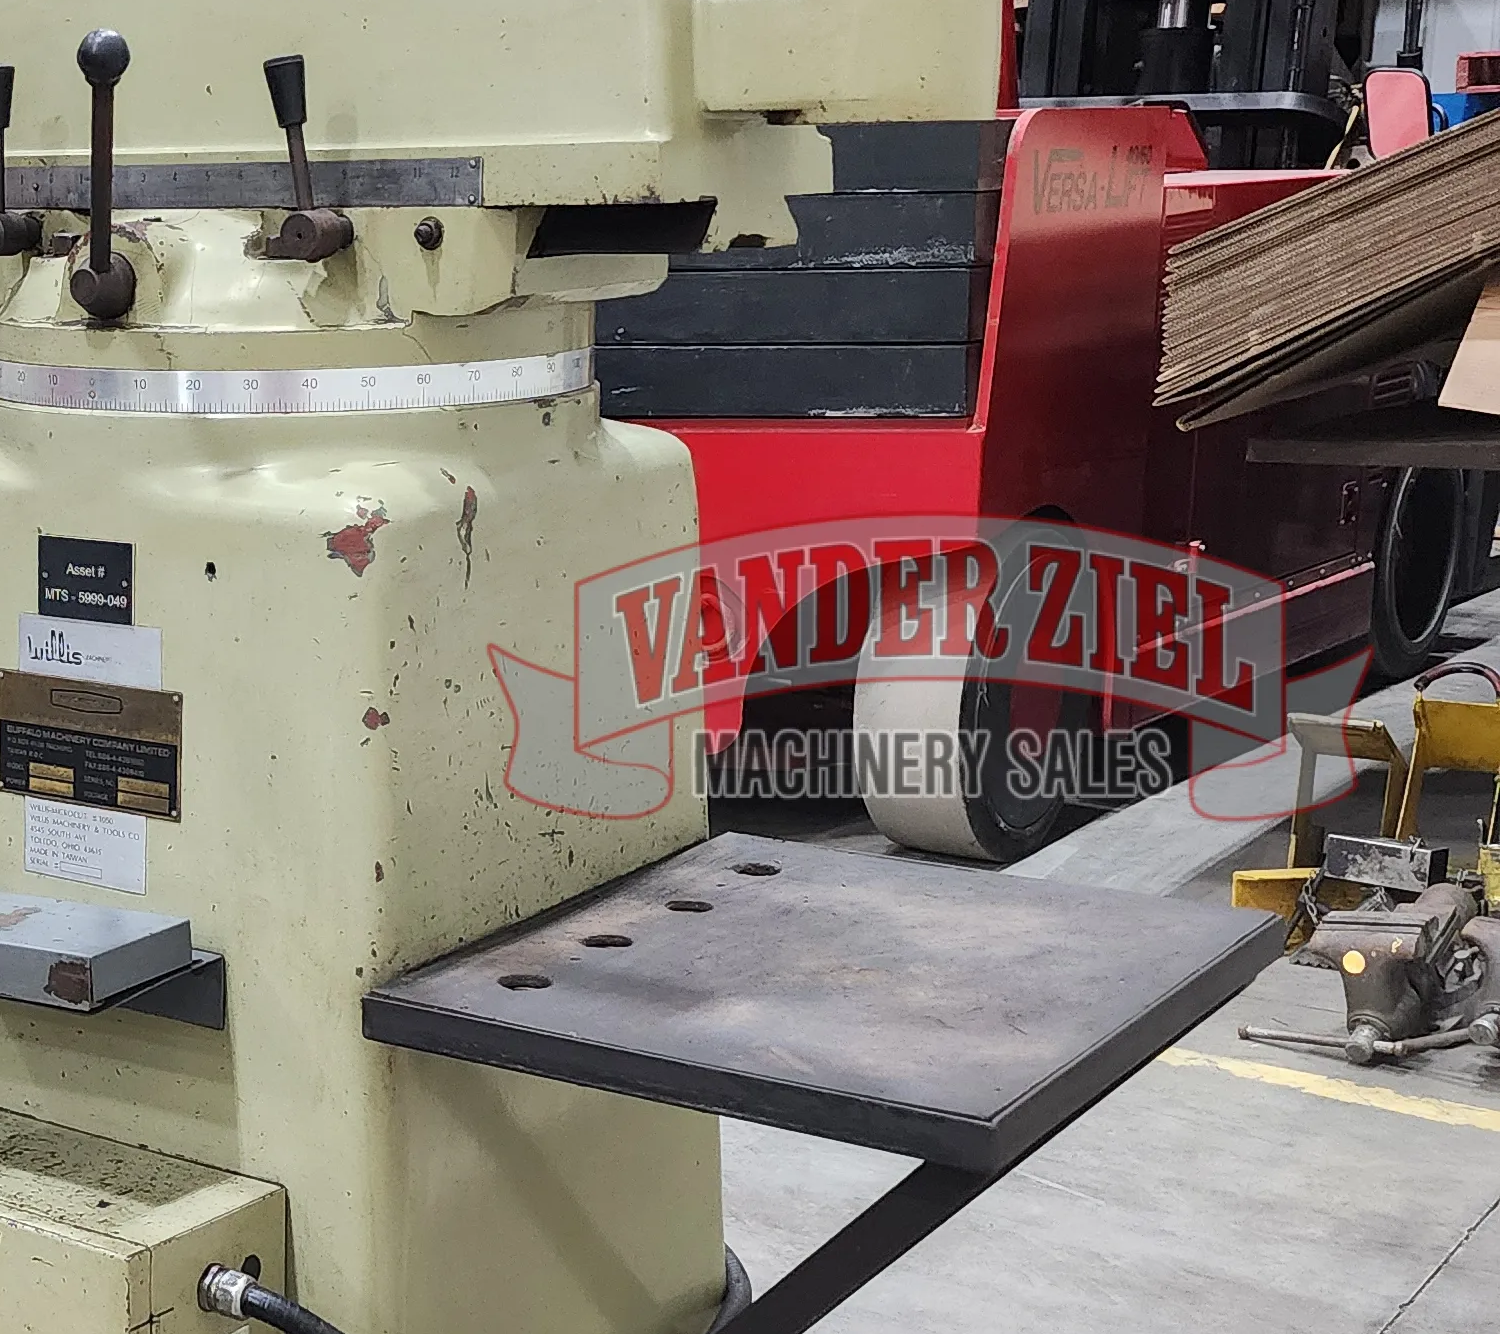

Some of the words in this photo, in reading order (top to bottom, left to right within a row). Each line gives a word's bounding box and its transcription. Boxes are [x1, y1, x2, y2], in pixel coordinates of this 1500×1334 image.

[48, 374, 58, 386] 10
[134, 379, 147, 390] 10
[186, 379, 201, 390] 20
[243, 379, 259, 390] 30
[302, 377, 318, 389] 40
[361, 376, 376, 388] 50
[416, 373, 431, 385] 60
[468, 370, 481, 381] 70
[511, 366, 523, 377] 80
[66, 563, 95, 577] Asset
[97, 566, 105, 578] #
[45, 587, 69, 601] MTS
[78, 591, 127, 608] 5999-049
[7, 724, 41, 738] BUFFALO
[43, 730, 92, 746] MACHINERY
[92, 738, 135, 752] COMPANY
[30, 814, 50, 824] WILLIS
[52, 818, 91, 832] MACHINERY
[103, 827, 126, 838] TOOLS
[47, 828, 71, 839] SOUTH
[30, 847, 48, 856] MADE
[62, 851, 88, 863] TAIWAN
